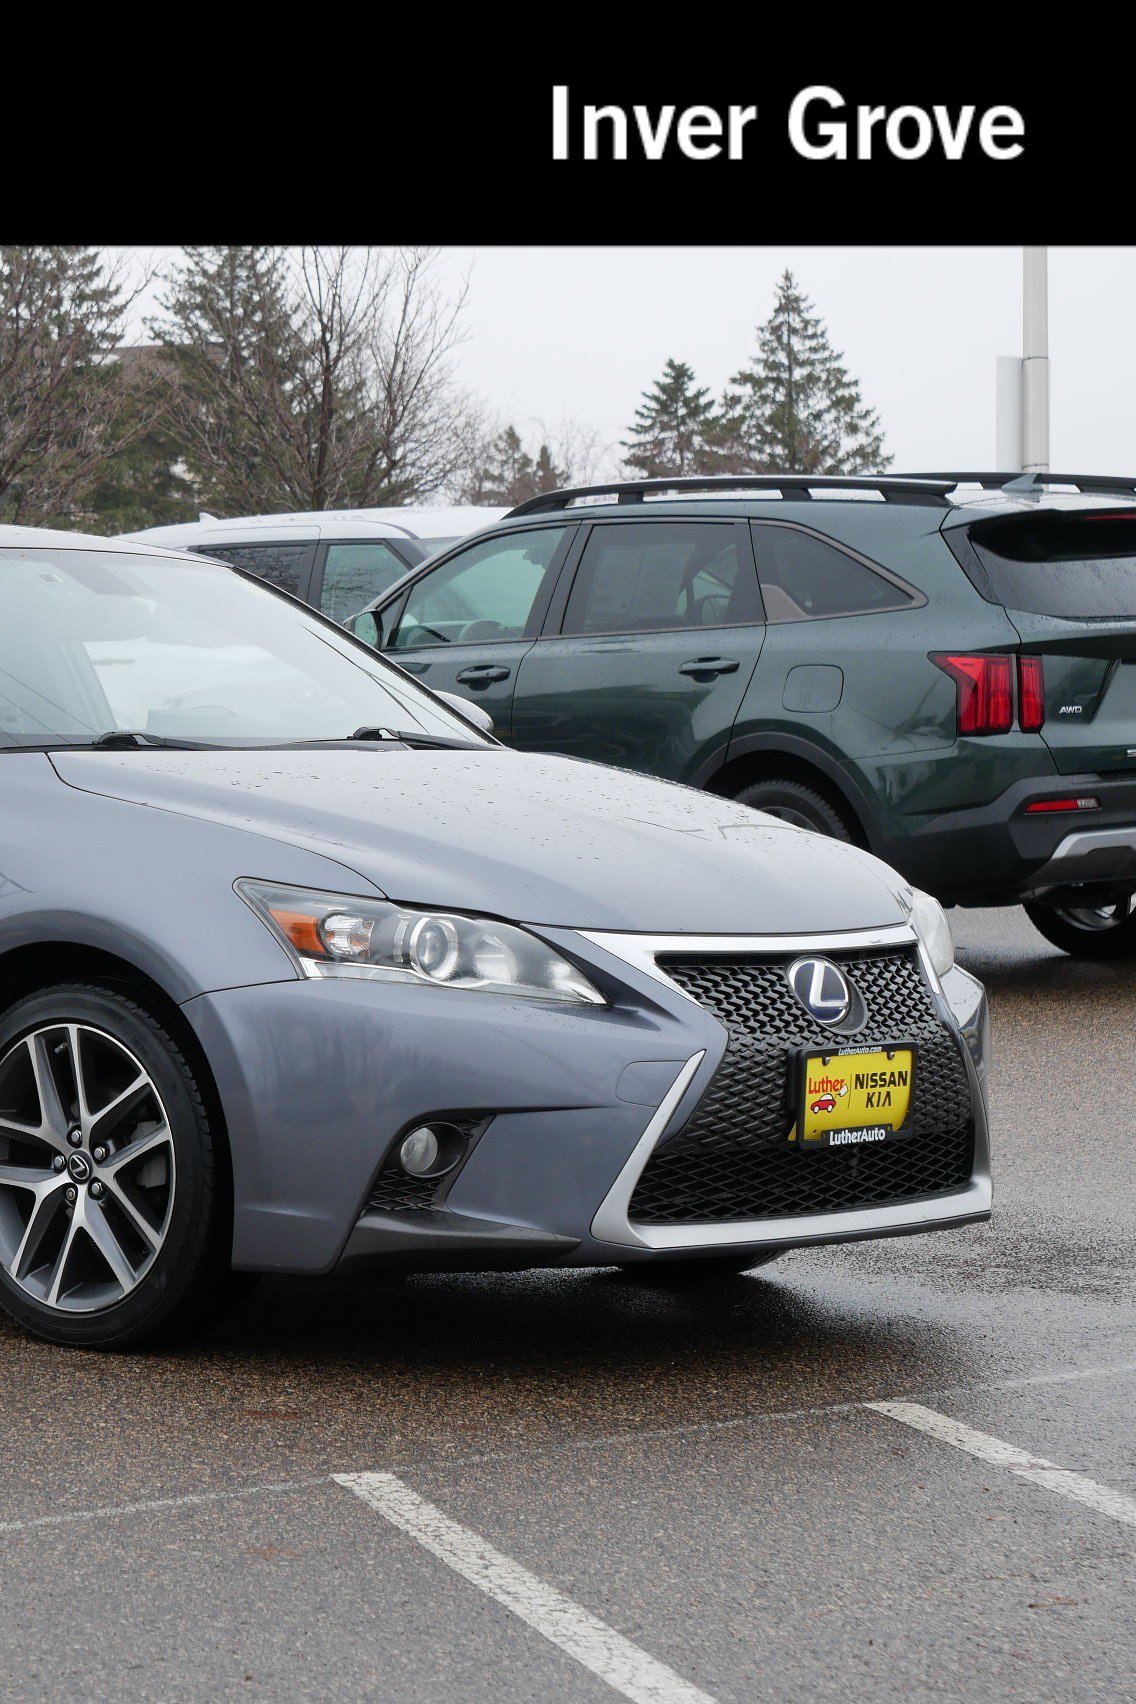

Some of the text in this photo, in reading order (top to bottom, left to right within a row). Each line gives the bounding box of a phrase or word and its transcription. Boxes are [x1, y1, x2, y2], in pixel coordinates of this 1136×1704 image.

[1059, 705, 1083, 714] AWD
[838, 1046, 883, 1056] LutherAuto.com
[808, 1075, 845, 1094] Luther
[854, 1070, 908, 1090] NISSAN
[865, 1091, 892, 1108] KIA
[829, 1129, 886, 1146] LutherAuto
